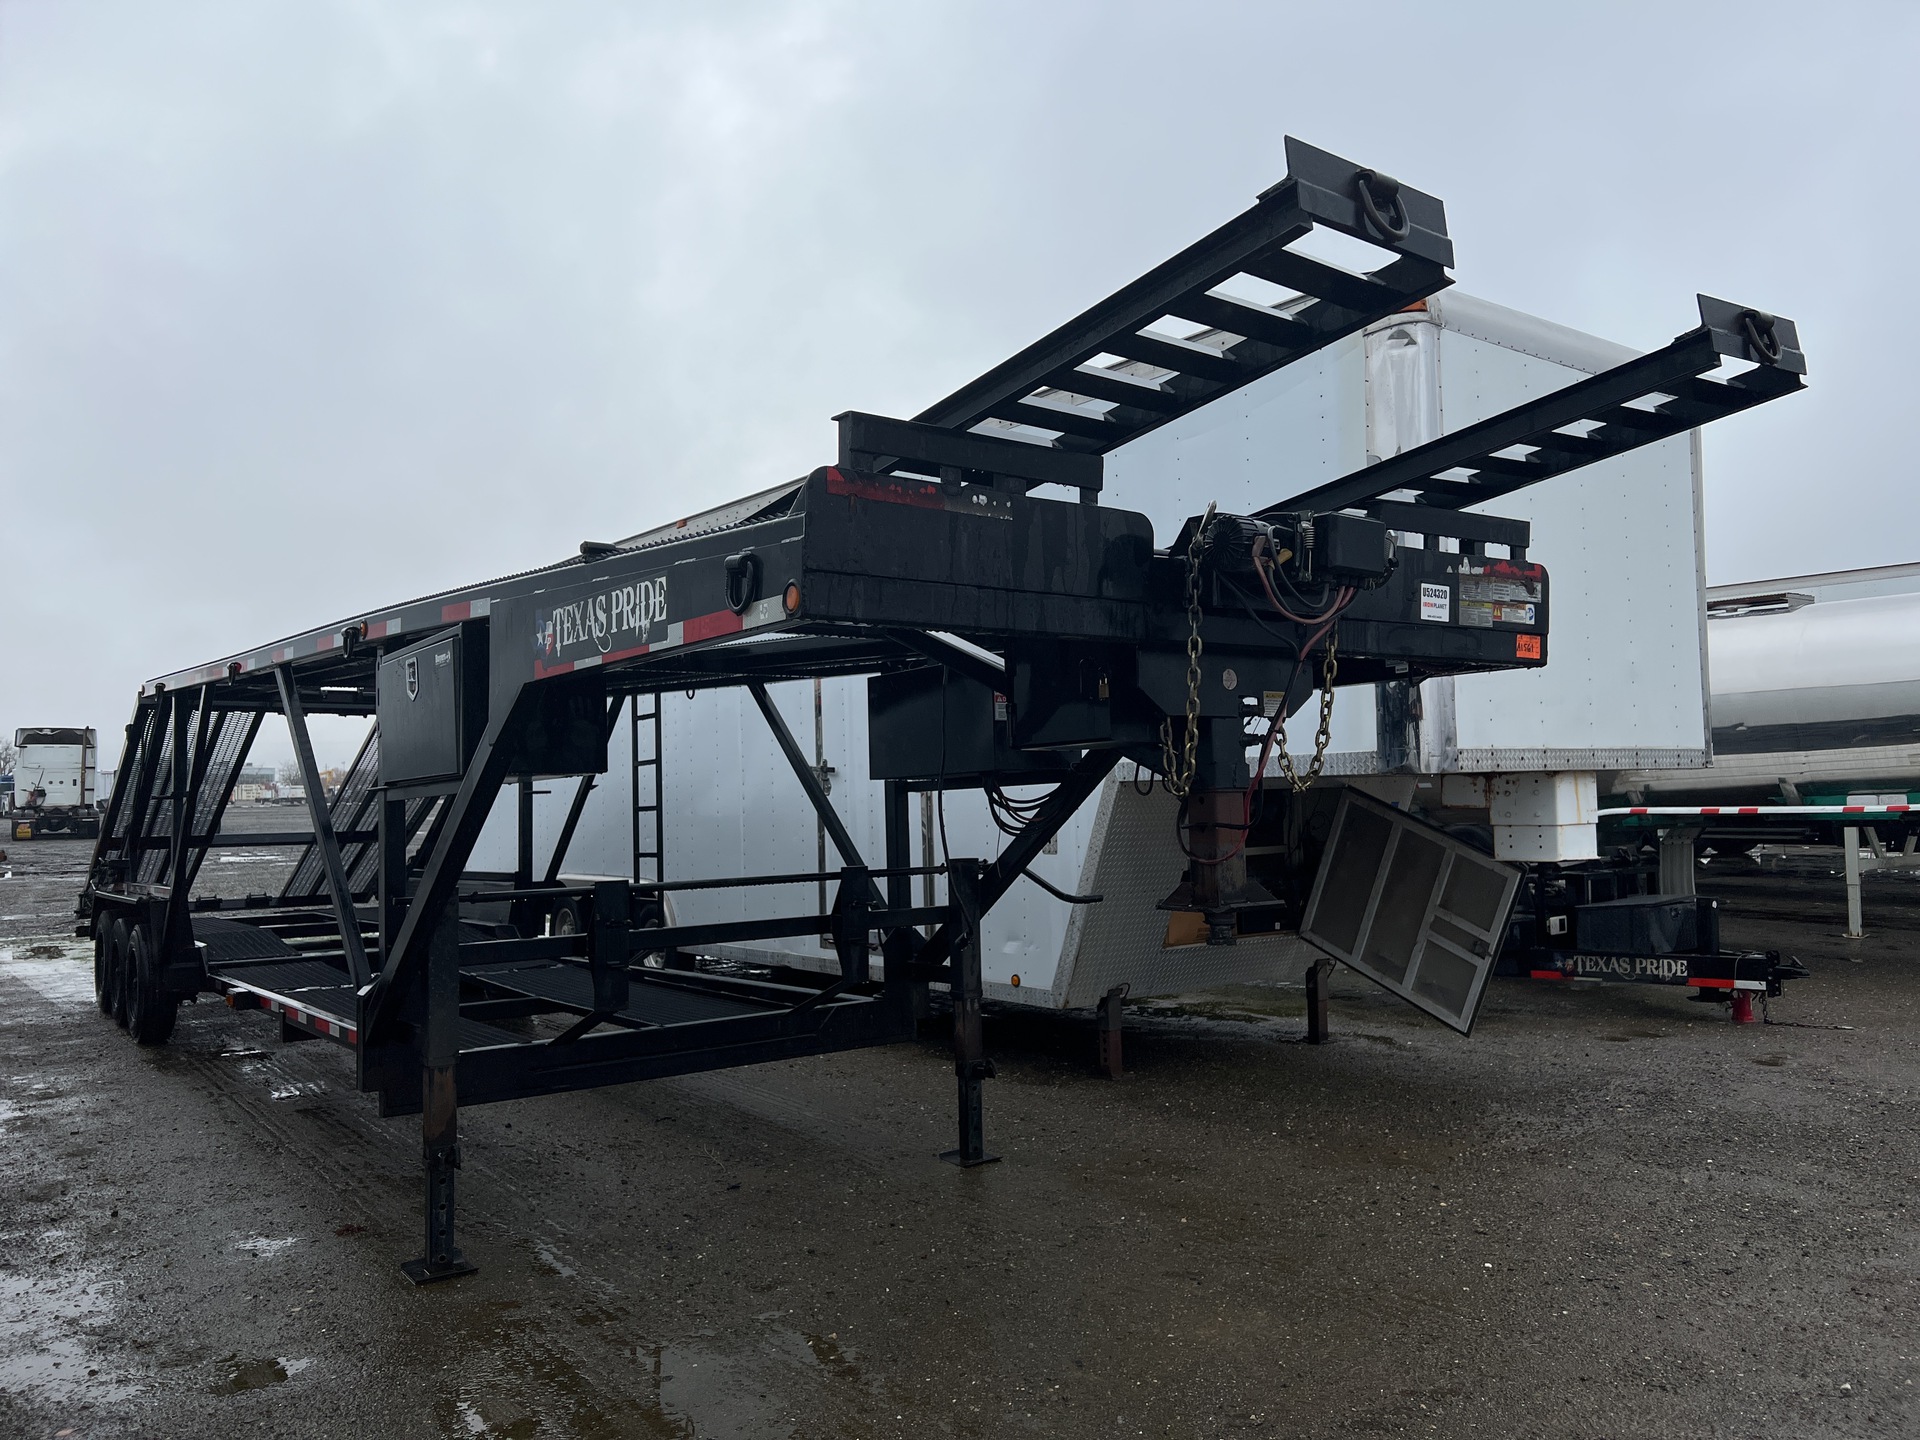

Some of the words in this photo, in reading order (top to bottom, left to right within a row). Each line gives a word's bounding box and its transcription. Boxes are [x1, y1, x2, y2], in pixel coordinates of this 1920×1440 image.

[1422, 587, 1448, 600] U524320
[552, 594, 612, 658] TEXAS
[611, 576, 667, 643] PRIDE
[1573, 955, 1636, 980] TEXAS
[1634, 957, 1688, 981] PRIDE
